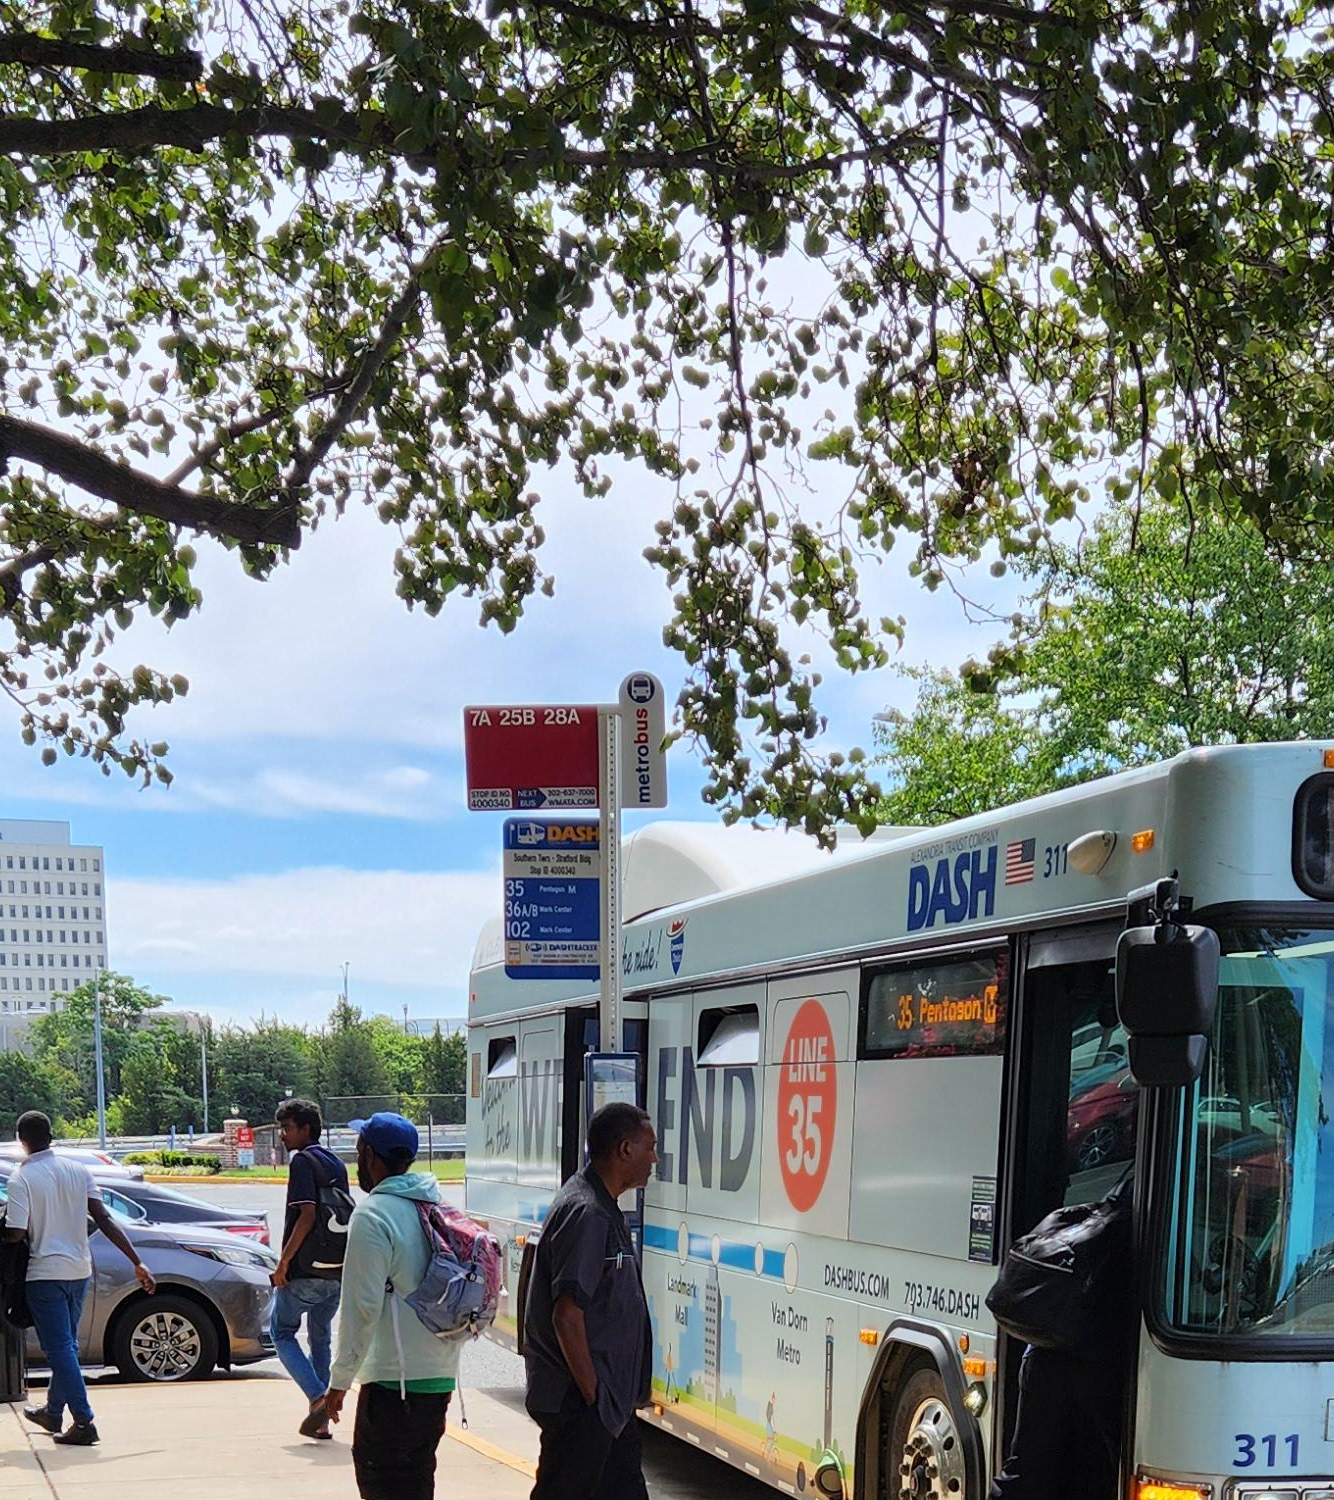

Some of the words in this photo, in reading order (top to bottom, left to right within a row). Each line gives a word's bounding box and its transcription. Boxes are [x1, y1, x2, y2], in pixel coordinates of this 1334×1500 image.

[470, 710, 492, 726] 7A
[499, 709, 535, 726] 25B
[544, 708, 580, 725] 28A
[634, 707, 651, 803] metrobus
[471, 790, 489, 798] STOP
[471, 798, 511, 808] 4000340
[519, 799, 537, 807] BUS
[548, 798, 595, 806] WMATA.COM
[547, 825, 601, 842] DASH
[968, 828, 1000, 849] COMPANY
[513, 853, 537, 863] Southern
[1043, 842, 1069, 878] 311
[530, 865, 542, 875] Stop
[506, 880, 525, 897] 35
[907, 845, 999, 932] DASH
[506, 901, 539, 917] 36A/B
[554, 905, 573, 913] Center
[506, 921, 531, 938] 102
[554, 926, 573, 934] Center
[897, 994, 914, 1030] 35
[919, 995, 982, 1024] Pentagon
[788, 1036, 828, 1083] LINE
[785, 1094, 823, 1176] 35
[667, 1272, 699, 1299] Landmark
[824, 1264, 890, 1300] DASHBUS.COM
[904, 1281, 981, 1320] 703.746.DASH
[675, 1305, 689, 1327] Mall
[771, 1301, 788, 1325] Van
[788, 1310, 808, 1332] Dorn
[776, 1338, 801, 1365] Metro
[1232, 1433, 1299, 1467] 311
